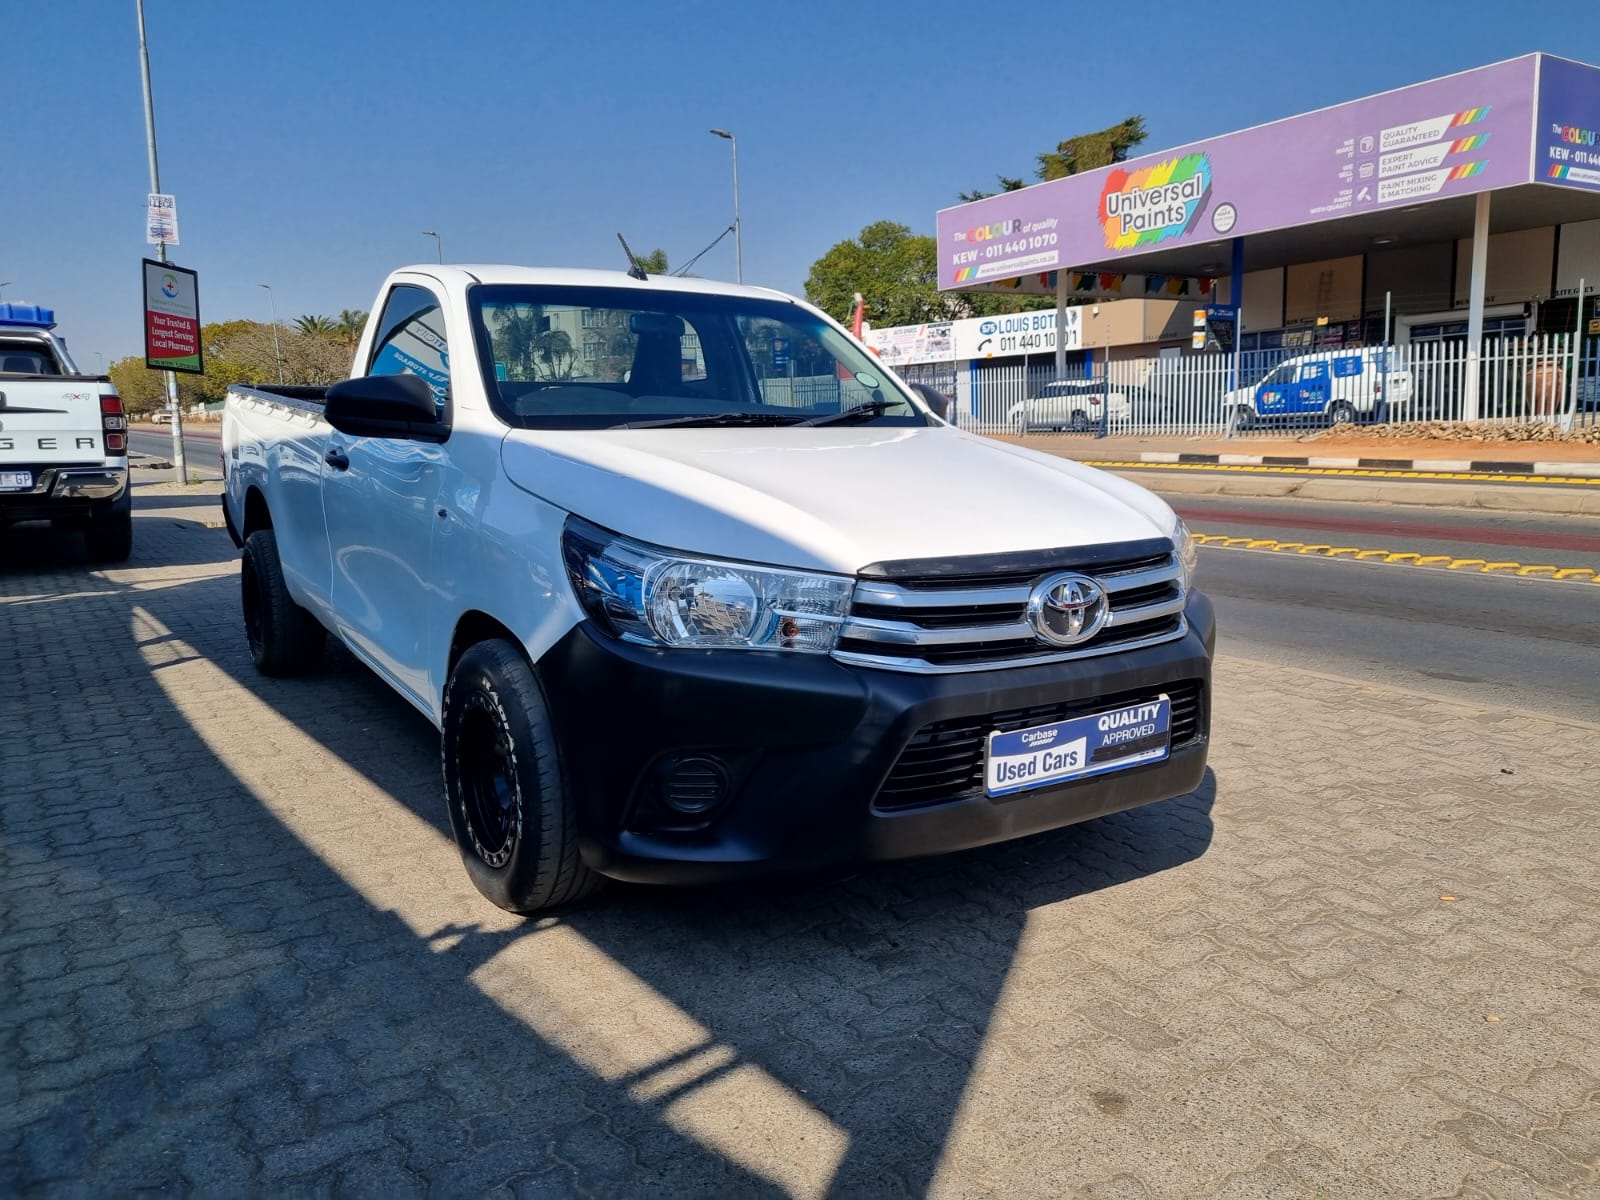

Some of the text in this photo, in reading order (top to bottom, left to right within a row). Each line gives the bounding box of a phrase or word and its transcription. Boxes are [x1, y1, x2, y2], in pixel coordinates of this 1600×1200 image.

[1382, 129, 1440, 148] GUARANTEED
[1383, 126, 1418, 140] QUALITY
[1382, 153, 1414, 166] EXPERT
[1550, 146, 1570, 161] KEW
[1575, 151, 1587, 164] 011
[1588, 153, 1600, 166] 44
[1382, 156, 1439, 174] PAINT ADVICE
[1381, 174, 1437, 191] PAINT MIXING
[1388, 184, 1431, 198] MATCHING
[1107, 175, 1201, 214] Universal
[1122, 205, 1184, 233] Paints
[954, 232, 966, 241] The
[967, 218, 1022, 244] COLOUR
[1031, 218, 1058, 233] quality
[953, 249, 978, 265] KEW
[986, 244, 1002, 258] 011
[1005, 239, 1027, 254] 440
[1029, 233, 1057, 249] 1070
[153, 315, 166, 325] Your
[167, 318, 185, 329] Trusted
[999, 317, 1029, 334] LOUIS
[152, 327, 194, 343] Longest Serving
[1001, 337, 1015, 351] 011
[1019, 334, 1040, 349] 440
[152, 338, 194, 354] Local Pharmacy
[1098, 704, 1161, 732] QUALITY
[1022, 729, 1057, 743] Carbase
[1102, 724, 1155, 746] APPROVED
[997, 750, 1078, 783] Used Cars
